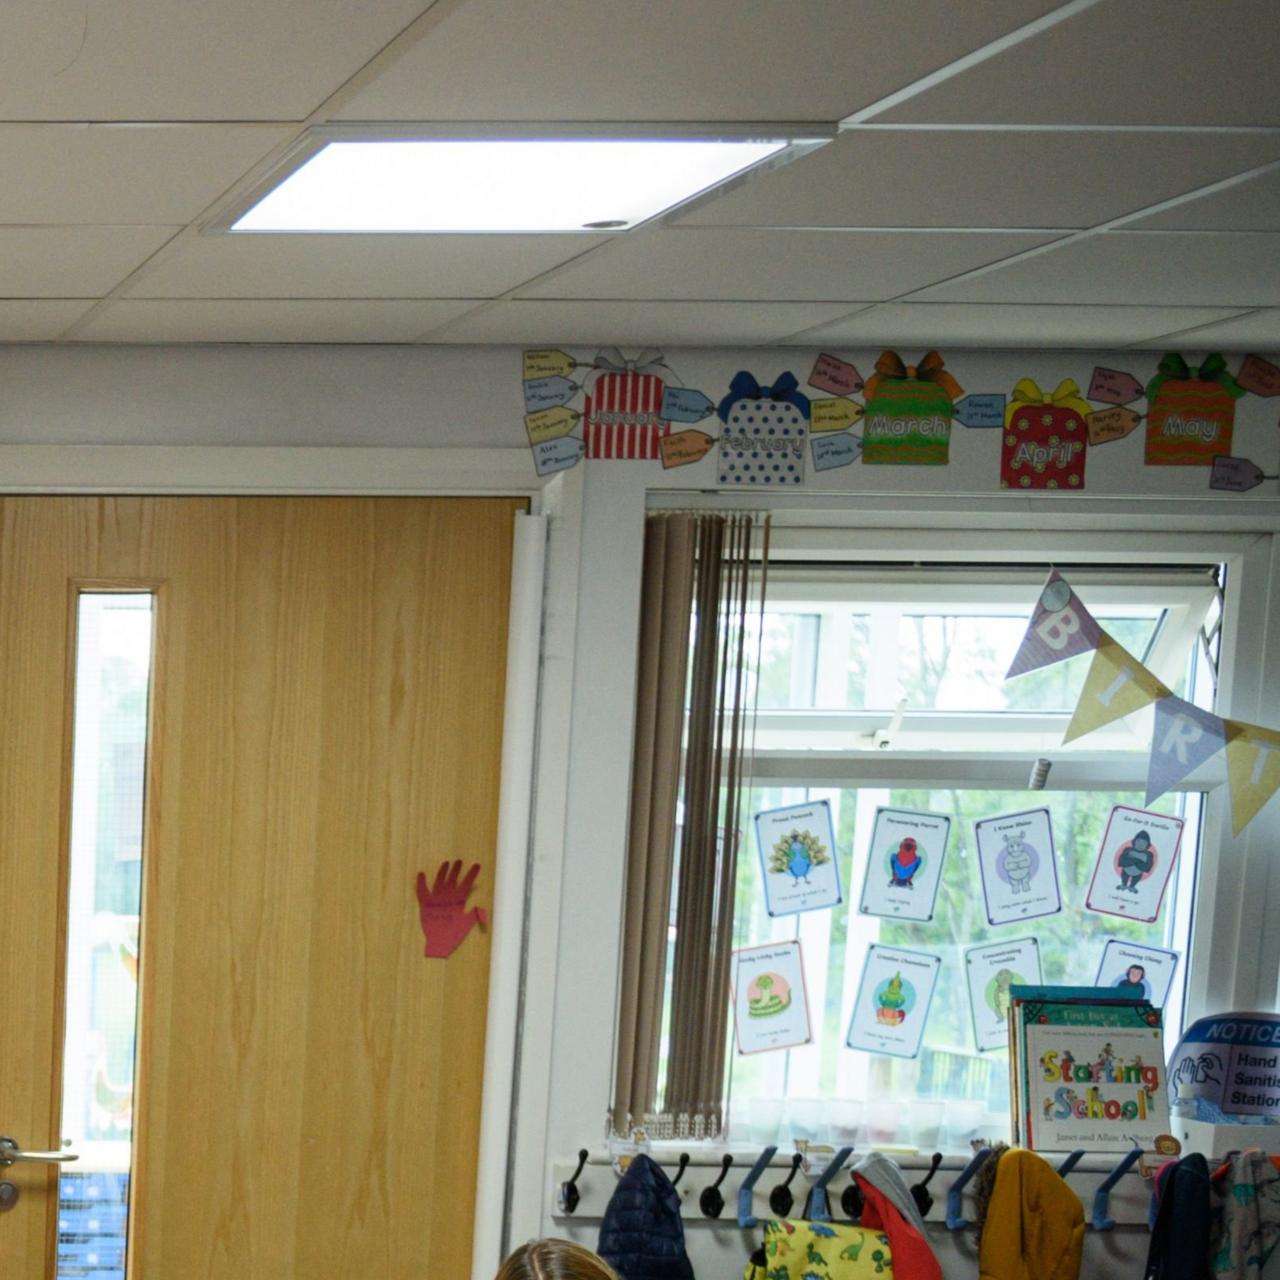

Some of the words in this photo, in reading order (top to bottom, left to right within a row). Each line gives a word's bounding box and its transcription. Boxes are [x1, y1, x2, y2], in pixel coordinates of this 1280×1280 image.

[589, 411, 666, 431] January
[869, 415, 948, 437] March
[1163, 415, 1217, 442] May
[720, 433, 802, 460] February
[1016, 442, 1073, 465] April
[1206, 1023, 1280, 1043] NOTICE
[1040, 1050, 1159, 1092] Starting
[1238, 1053, 1277, 1068] Hand
[1054, 1086, 1148, 1121] School
[1055, 1132, 1078, 1144] Janet
[1080, 1132, 1094, 1142] and
[1096, 1132, 1121, 1143] Allan
